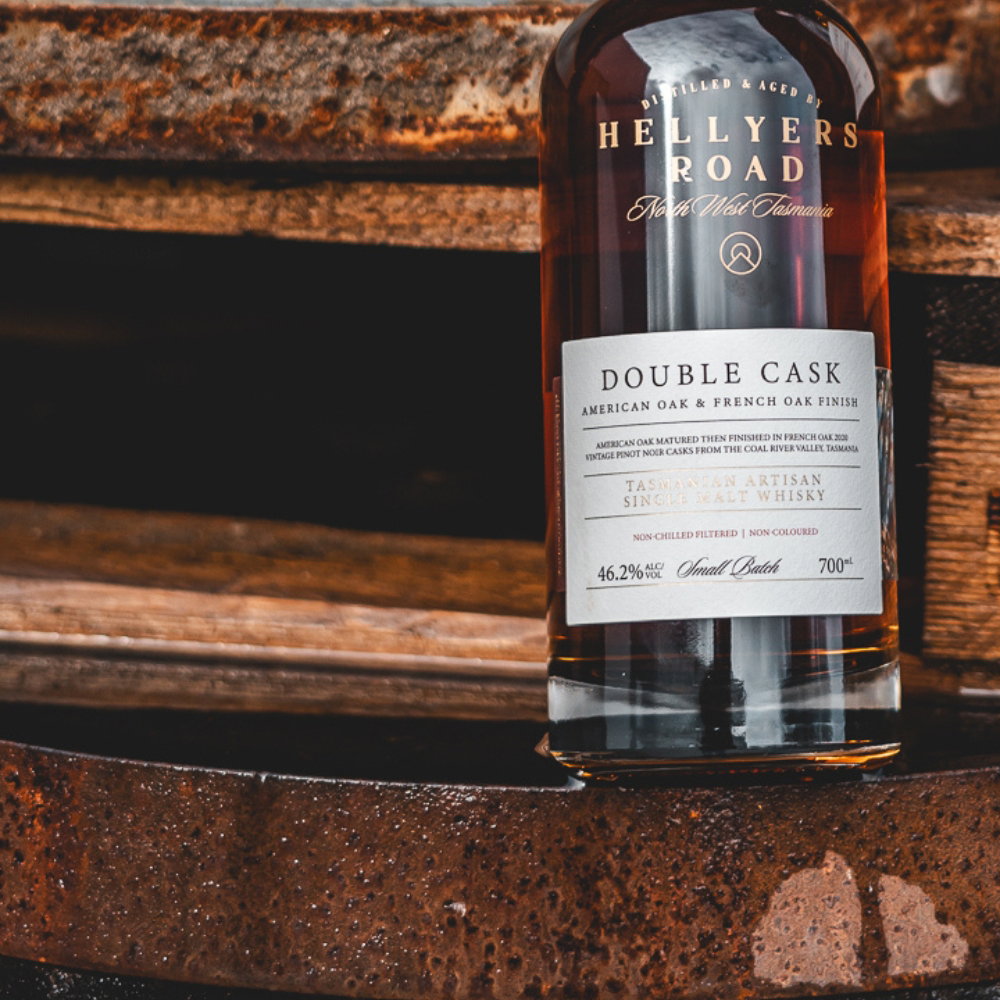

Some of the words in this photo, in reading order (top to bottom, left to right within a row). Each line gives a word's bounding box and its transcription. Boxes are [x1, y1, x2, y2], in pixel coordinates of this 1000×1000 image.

[641, 78, 731, 110] DITILLED
[742, 79, 751, 89] &
[758, 80, 798, 97] AGED
[806, 93, 823, 109] BY
[599, 115, 858, 149] HELLYERS
[671, 155, 804, 182] ROAD
[691, 192, 753, 217] West
[752, 192, 834, 218] Tasmania
[601, 362, 740, 391] DOUBLE
[760, 361, 841, 384] CASK
[582, 400, 650, 416] AMERICAN
[657, 398, 688, 410] OAK
[695, 399, 705, 408] &
[714, 397, 776, 408] FRENCH
[784, 396, 813, 406] OAK
[818, 396, 858, 408] FINISH
[595, 438, 635, 450] AMERICAN
[636, 437, 654, 446] OAK
[656, 435, 699, 446] MATURED
[700, 434, 727, 443] THEN
[729, 433, 771, 442] FINISHED
[772, 433, 783, 441] IN
[784, 433, 816, 441] FRENCH
[817, 433, 834, 441] OAK
[585, 451, 615, 461] VINTAGE
[616, 449, 640, 459] PINOT
[642, 448, 665, 457] NOIR
[666, 447, 693, 455] CASKS
[695, 446, 721, 455] FROM
[724, 445, 741, 453] THE
[744, 444, 768, 453] COAL
[770, 444, 795, 452] RIVER
[825, 444, 859, 453] TASMANIA
[625, 475, 736, 492] TASMANIAN
[745, 473, 822, 487] ARTISAN
[623, 493, 688, 508] SINGLE
[696, 491, 748, 504] MALT
[757, 489, 825, 503] WHISKY
[633, 530, 694, 541] NON-CHILLED
[695, 529, 738, 539] FILTERED
[597, 563, 643, 581] 46.2%
[645, 571, 663, 579] VOL
[677, 556, 735, 579] Small
[729, 555, 783, 579] Batch
